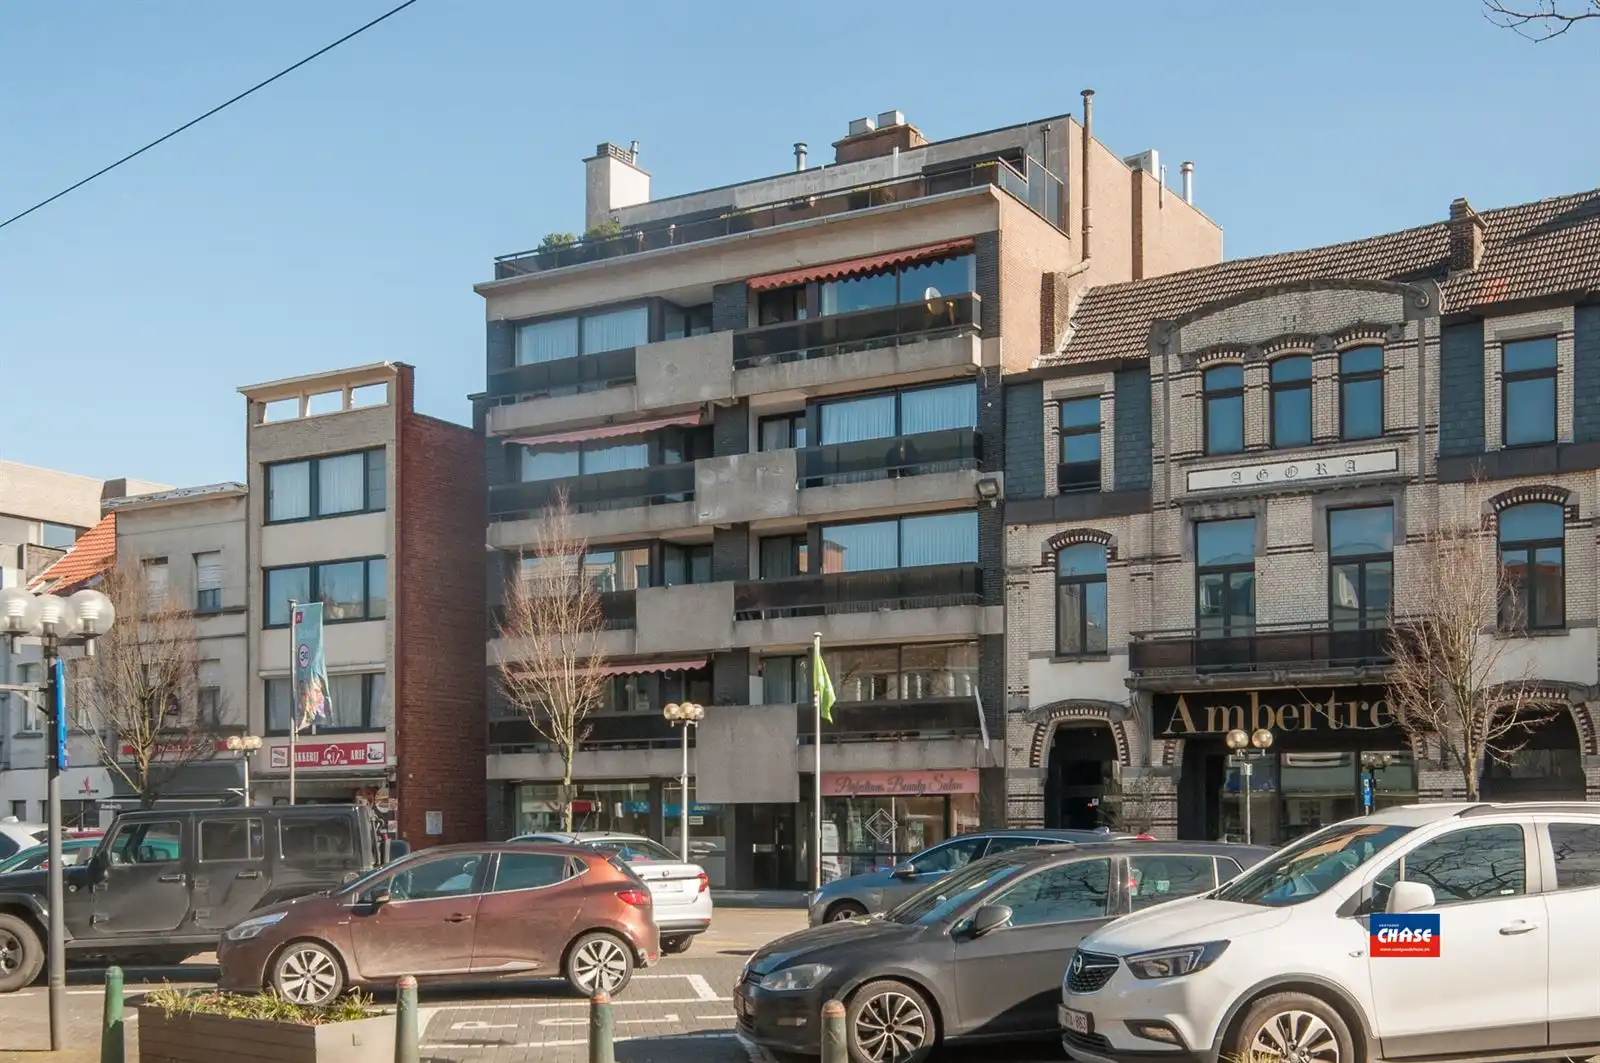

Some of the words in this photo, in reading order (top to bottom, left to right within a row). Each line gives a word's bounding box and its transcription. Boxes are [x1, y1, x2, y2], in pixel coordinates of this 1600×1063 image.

[1231, 459, 1357, 485] AGORA
[1161, 689, 1409, 735] Ambertre
[929, 773, 964, 792] Salon
